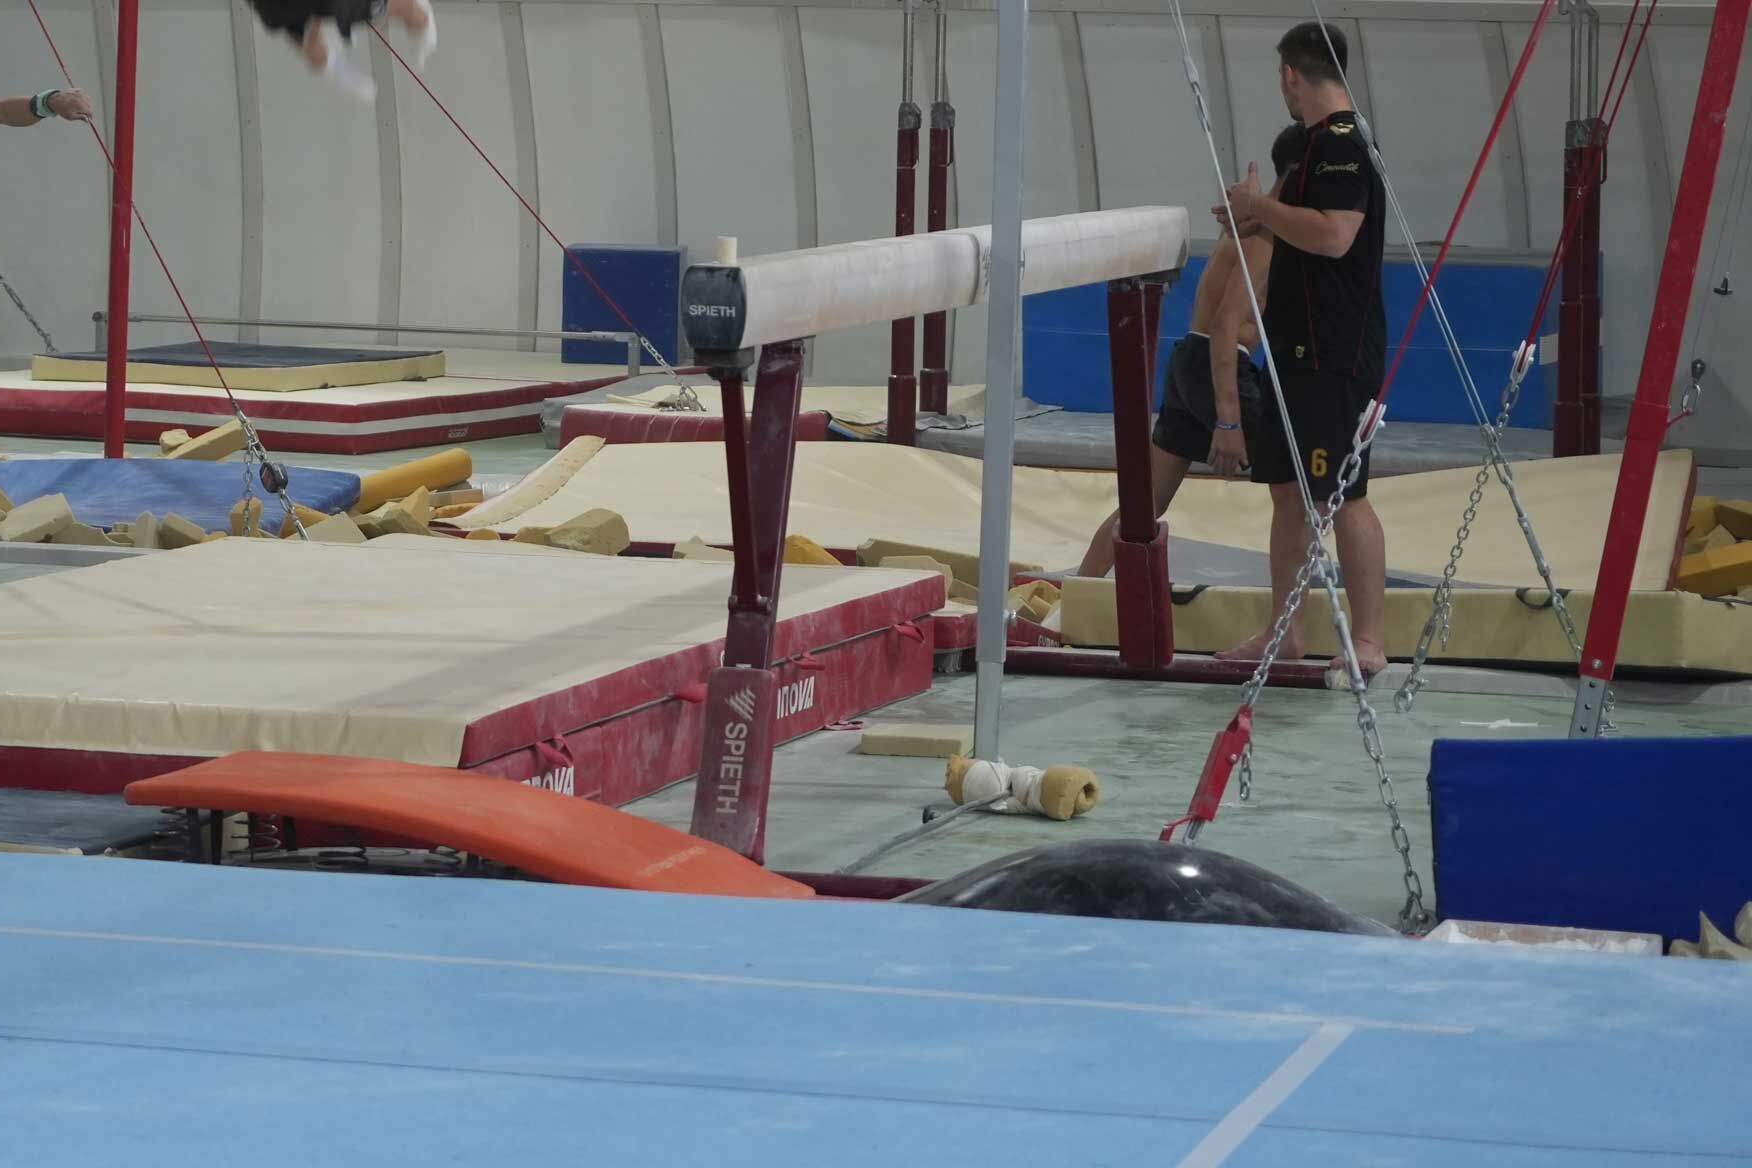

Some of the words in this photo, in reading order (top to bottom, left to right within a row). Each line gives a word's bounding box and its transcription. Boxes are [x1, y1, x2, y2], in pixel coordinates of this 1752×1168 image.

[689, 304, 736, 318] SPIETH
[1311, 448, 1328, 478] 6
[715, 721, 748, 814] SPIETH
